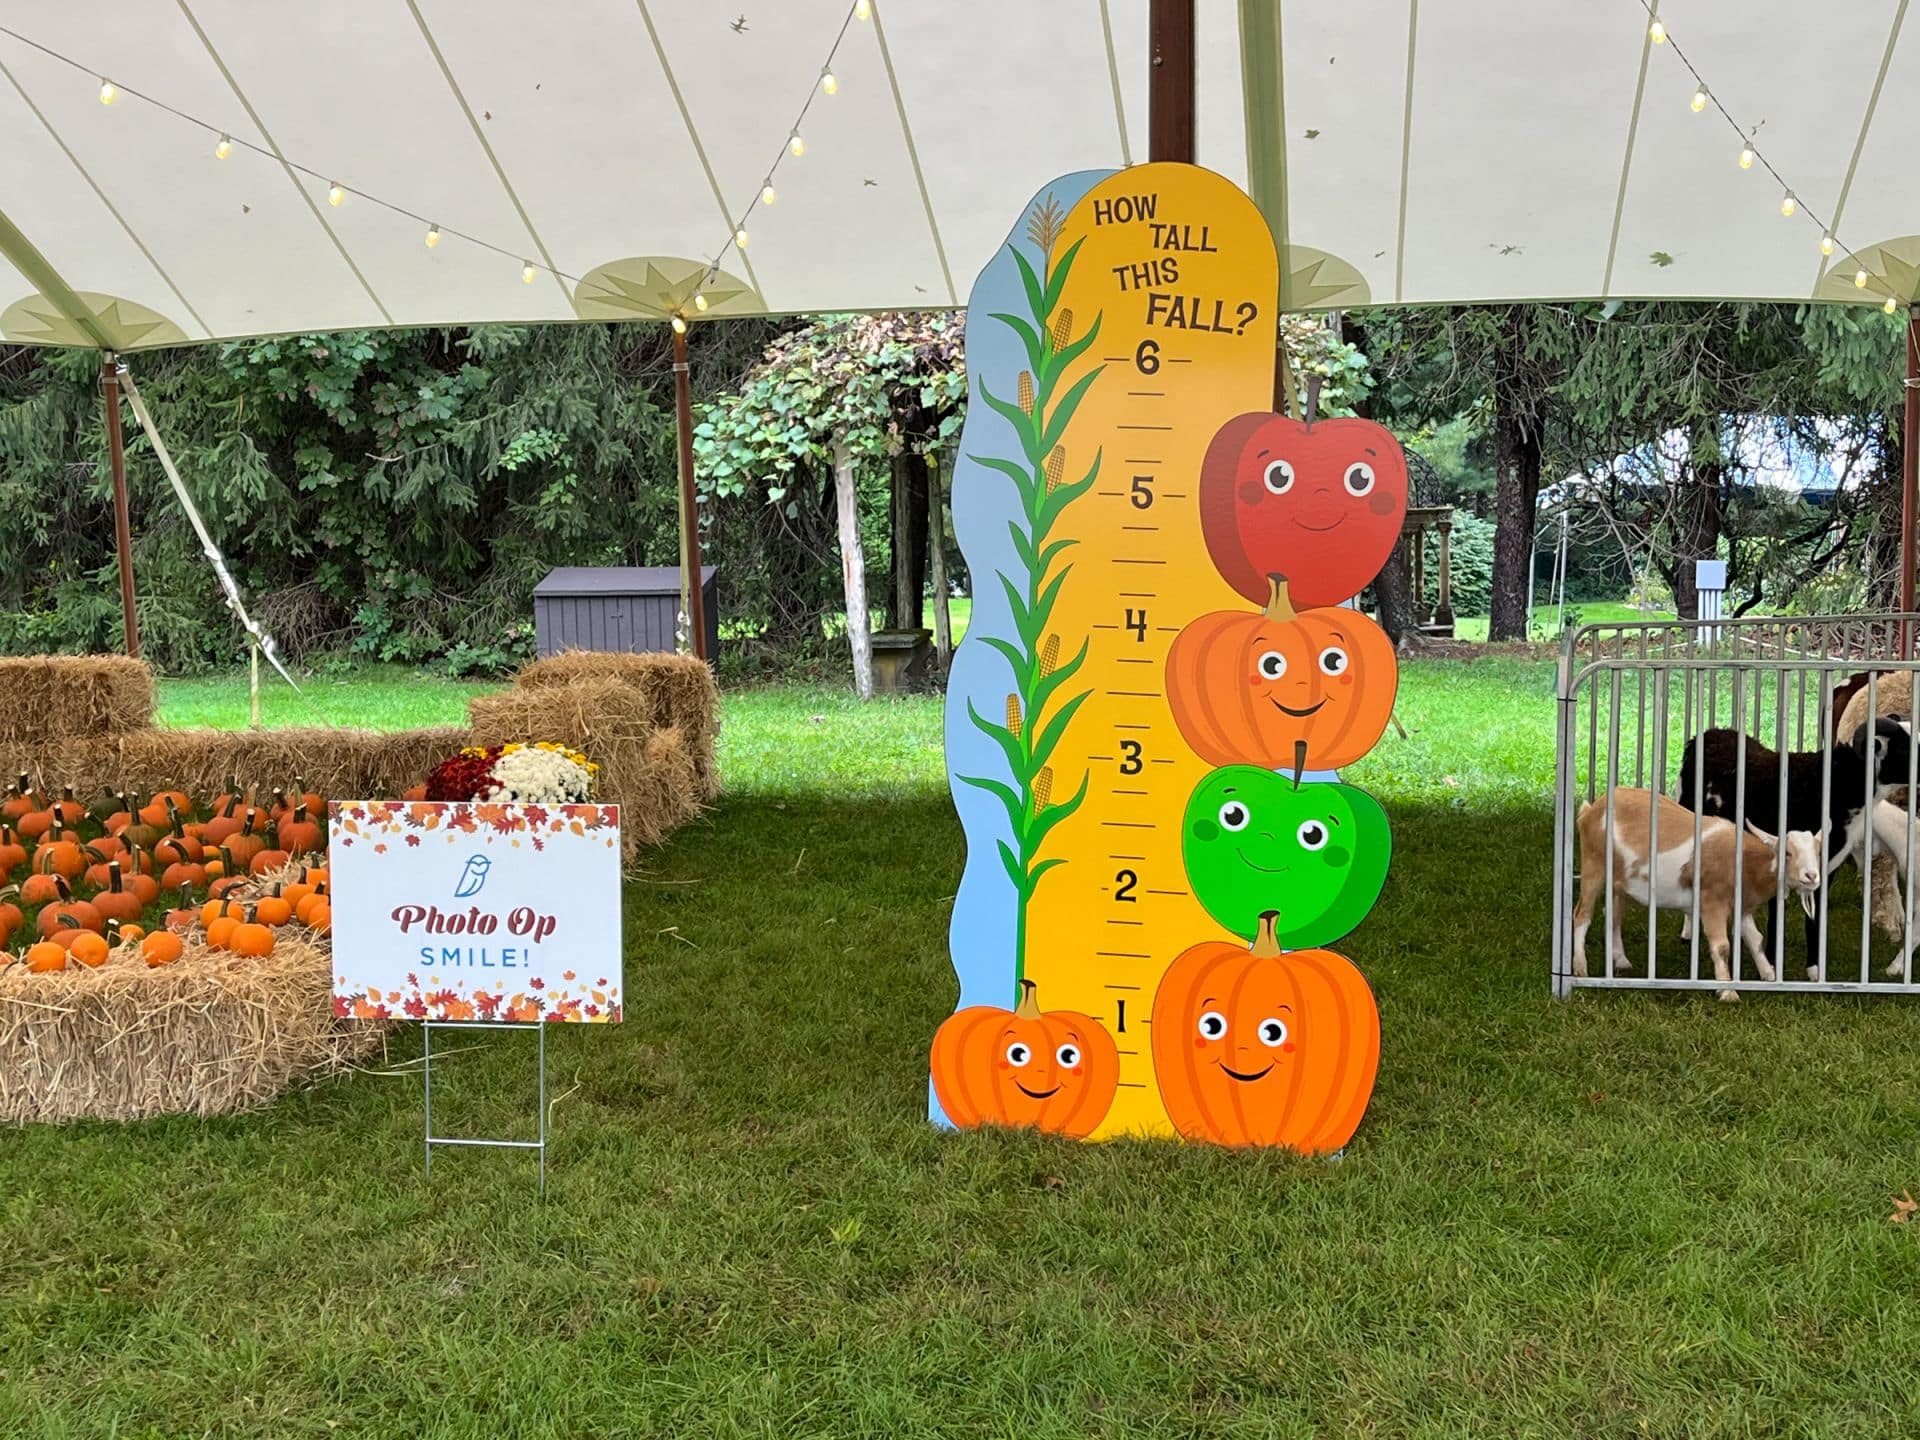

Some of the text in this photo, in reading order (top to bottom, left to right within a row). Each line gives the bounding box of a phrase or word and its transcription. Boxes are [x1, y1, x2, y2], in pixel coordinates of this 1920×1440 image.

[1093, 193, 1158, 226] HOW
[1149, 223, 1218, 253] TALL
[1112, 257, 1179, 291] THIS
[1146, 292, 1258, 336] FALL?
[1135, 339, 1160, 376] 6
[1130, 475, 1154, 510] 5
[1125, 608, 1147, 643] 4
[1119, 739, 1144, 776] 3
[1114, 868, 1138, 904] 2
[391, 904, 557, 944] Photo Op
[420, 947, 529, 968] SMILE!
[1116, 999, 1126, 1034] 1
